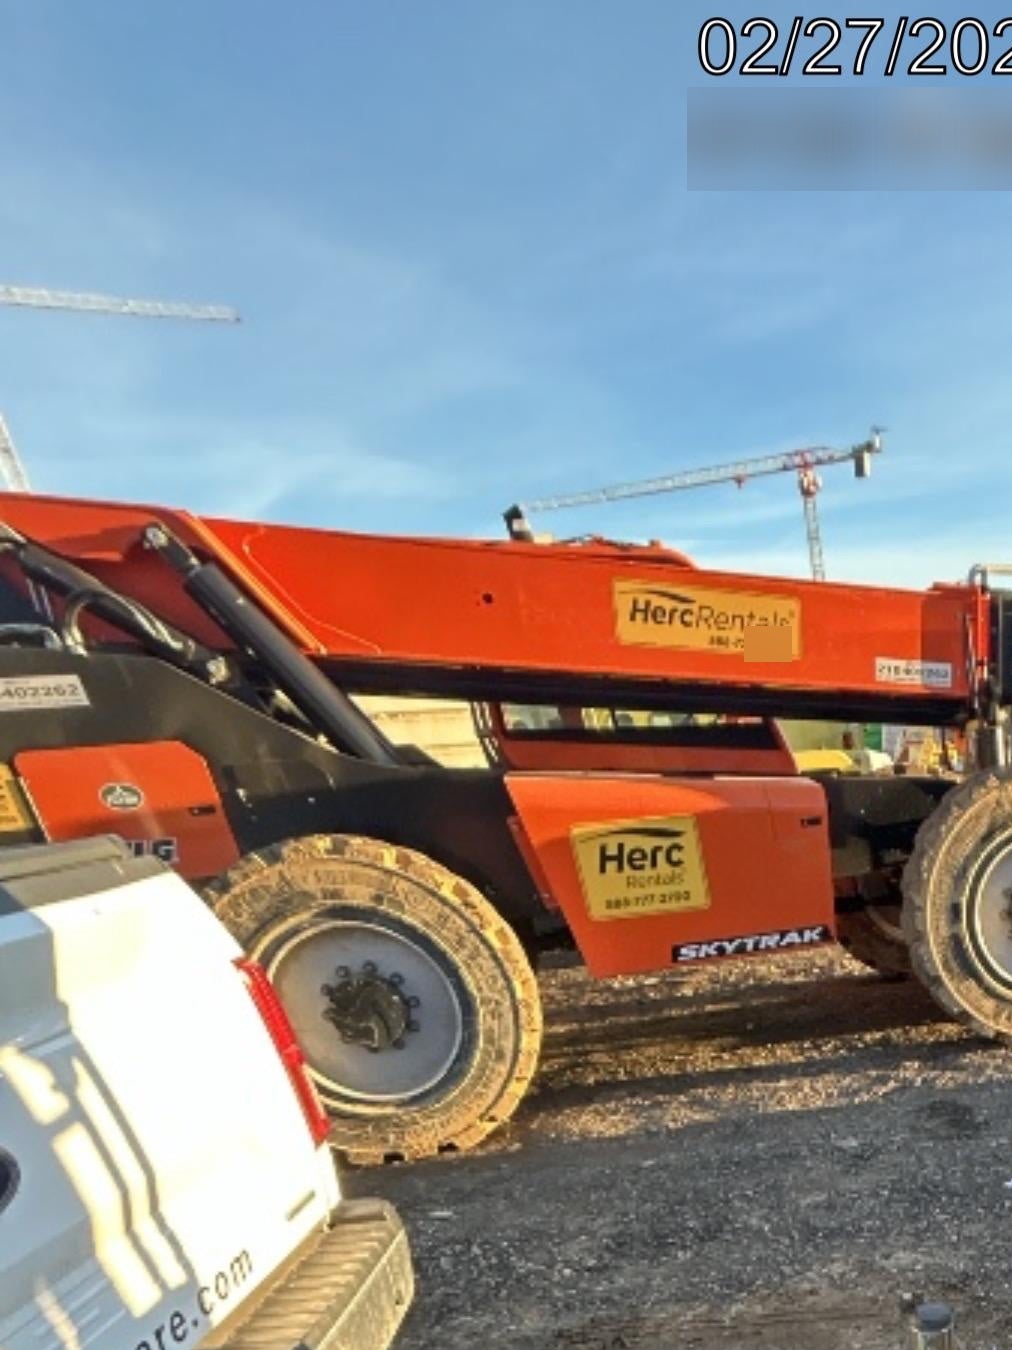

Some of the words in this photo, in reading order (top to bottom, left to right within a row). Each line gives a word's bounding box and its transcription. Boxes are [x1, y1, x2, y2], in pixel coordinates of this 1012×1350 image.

[598, 842, 684, 874] Herc
[626, 867, 684, 889] Rentals
[677, 926, 823, 961] SKYTRAK
